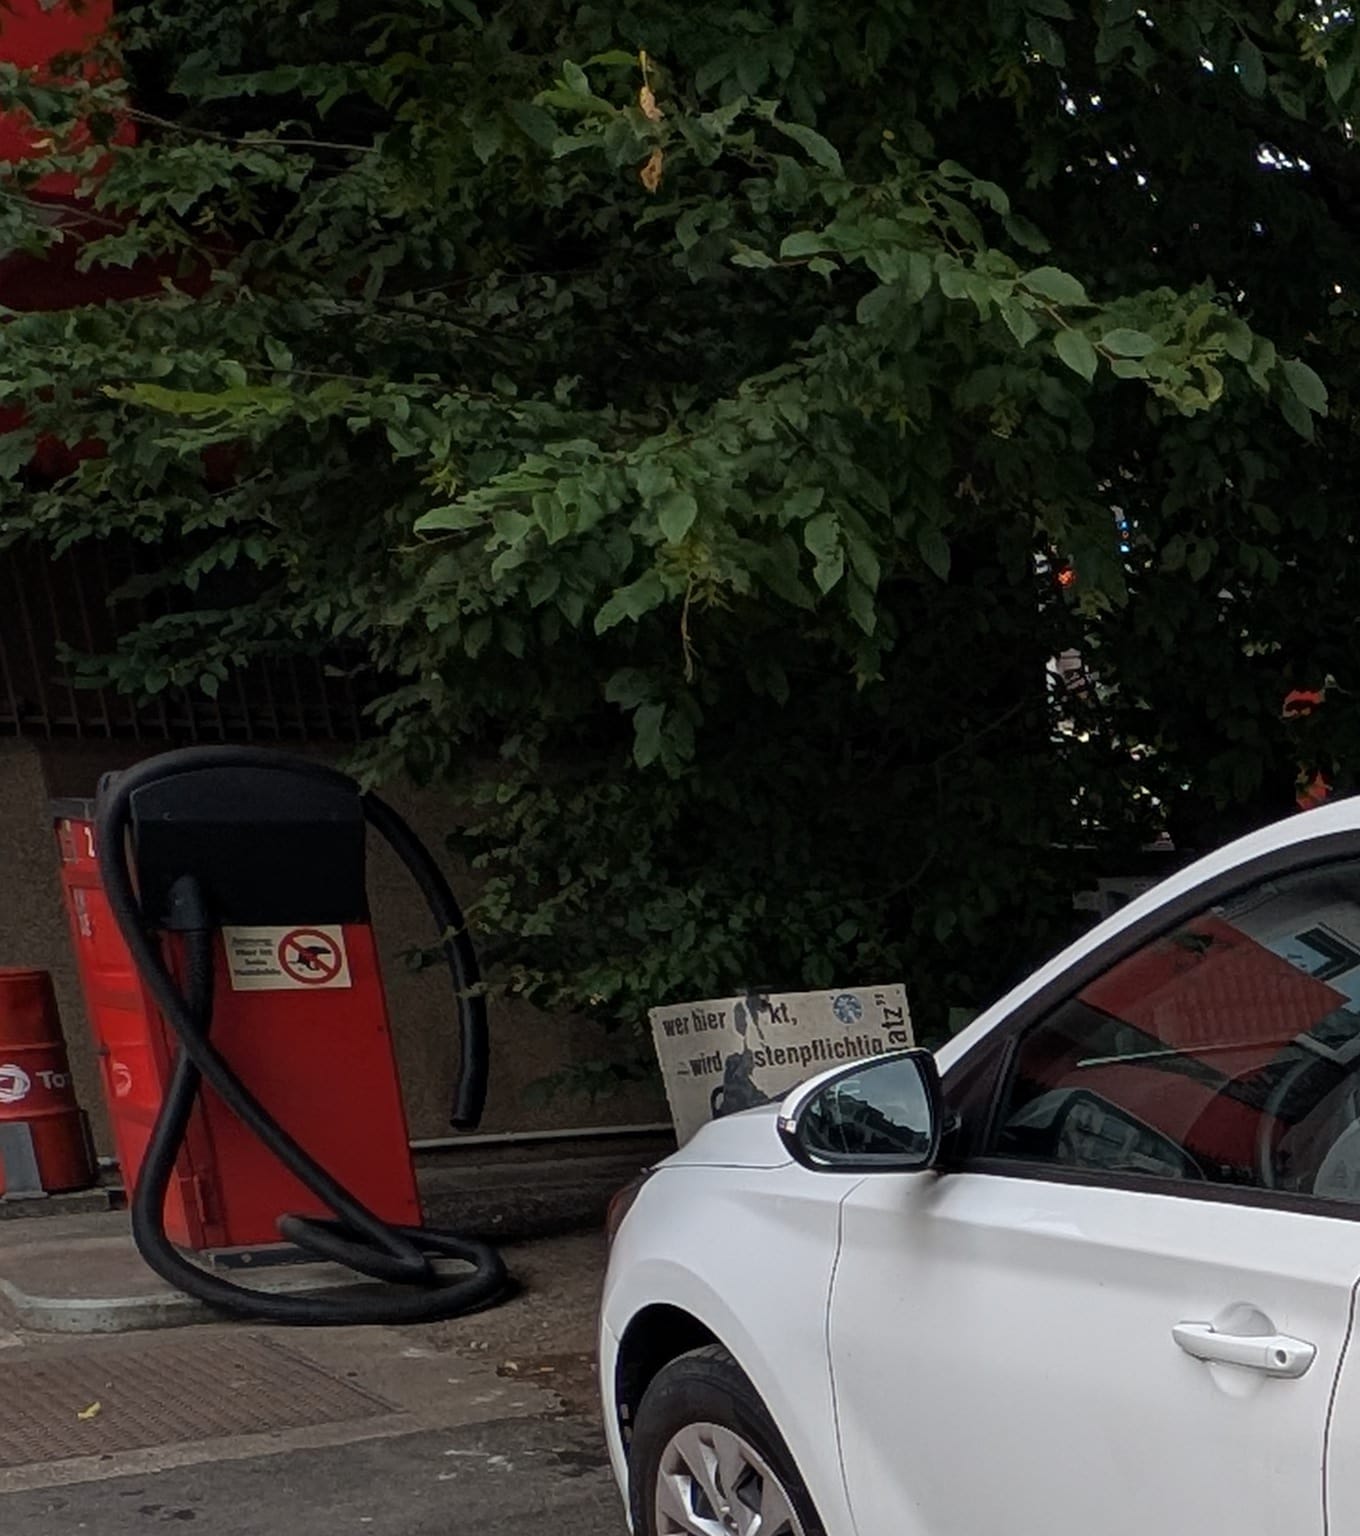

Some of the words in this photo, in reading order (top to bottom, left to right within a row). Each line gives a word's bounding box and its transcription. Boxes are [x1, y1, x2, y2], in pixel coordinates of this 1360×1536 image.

[662, 1016, 690, 1037] wer
[691, 1007, 727, 1033] hier
[754, 1033, 884, 1068] stenpflichtig
